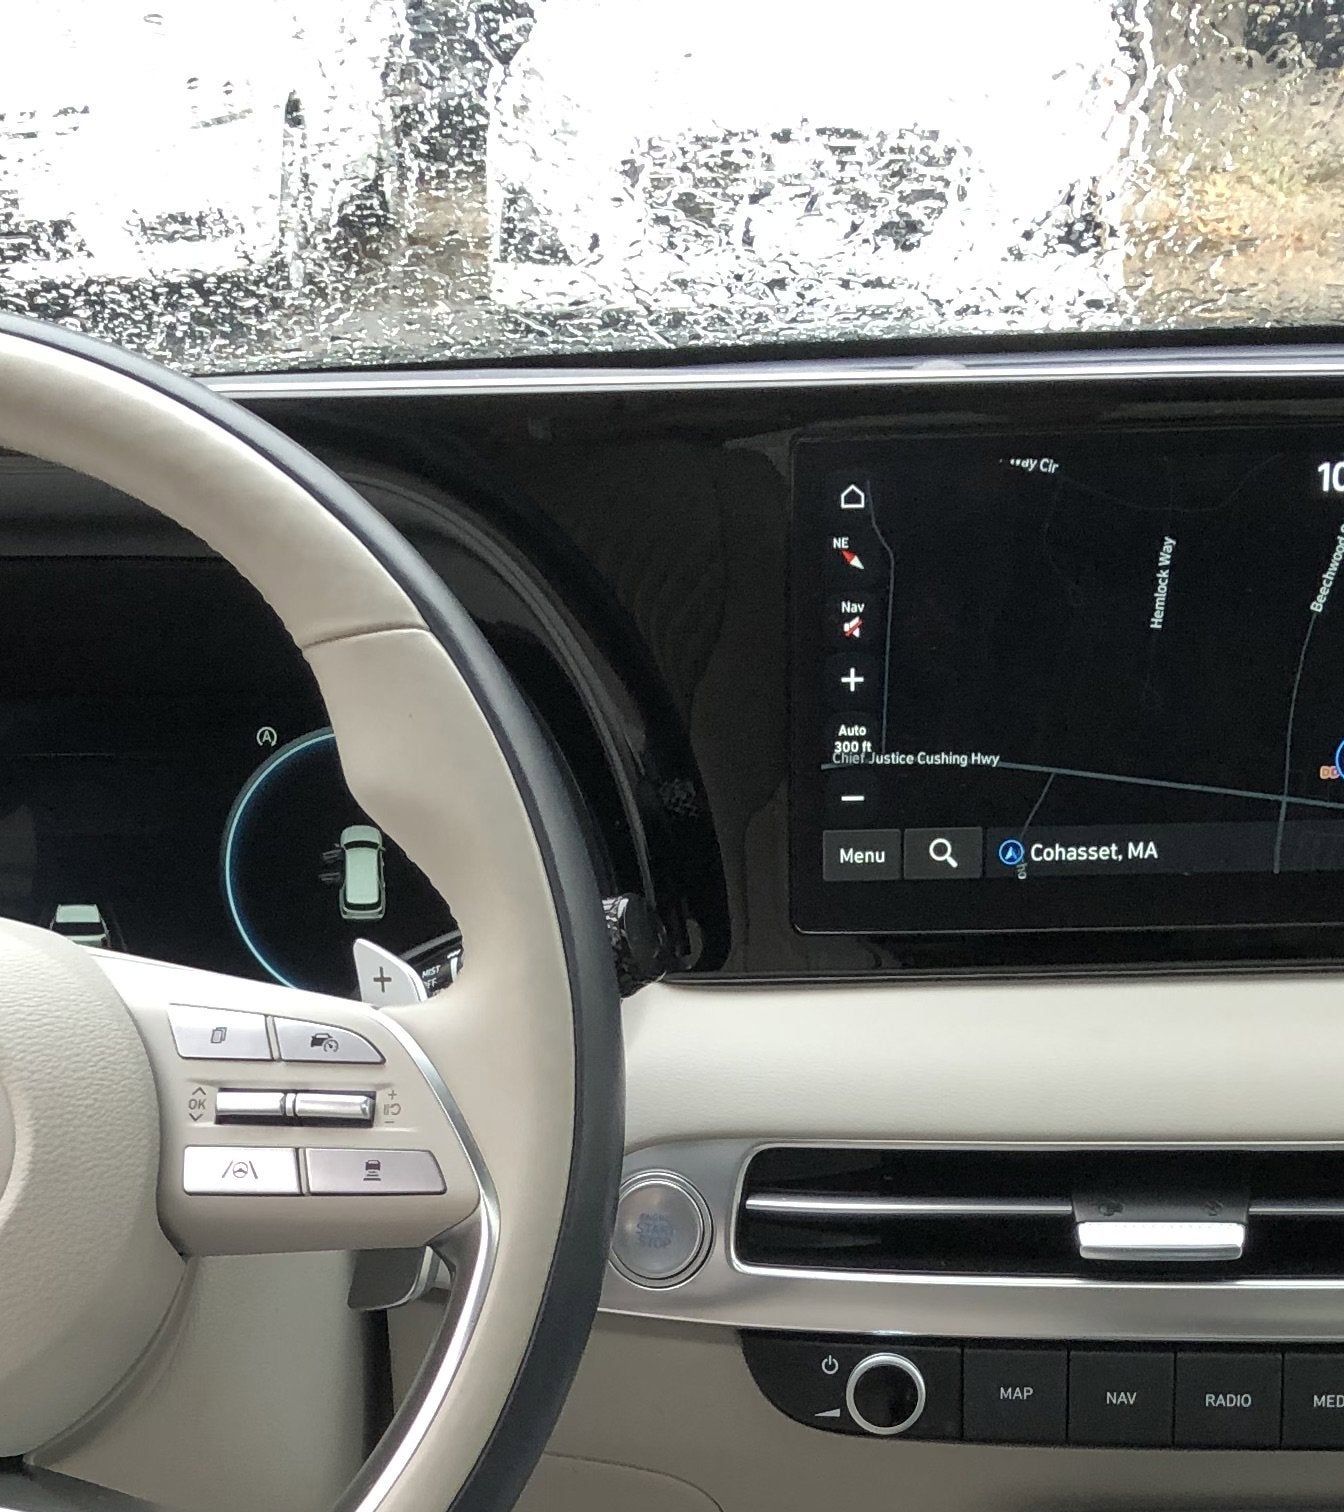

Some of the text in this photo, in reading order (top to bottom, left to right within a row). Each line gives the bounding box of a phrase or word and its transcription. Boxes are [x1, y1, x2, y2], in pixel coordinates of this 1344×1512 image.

[832, 537, 850, 549] NE
[1149, 535, 1176, 630] Hemlock Way
[840, 600, 865, 614] Nav
[838, 723, 867, 737] Auto
[834, 740, 872, 753] 300 ft
[832, 752, 1000, 767] Chief Justice Cushing Hwy
[839, 848, 885, 864] Menu
[1030, 842, 1158, 862] Cohasset, MA
[188, 1098, 207, 1111] OK
[999, 1386, 1034, 1401] MAP
[1105, 1391, 1137, 1406] NAV
[1205, 1393, 1252, 1408] RADIO
